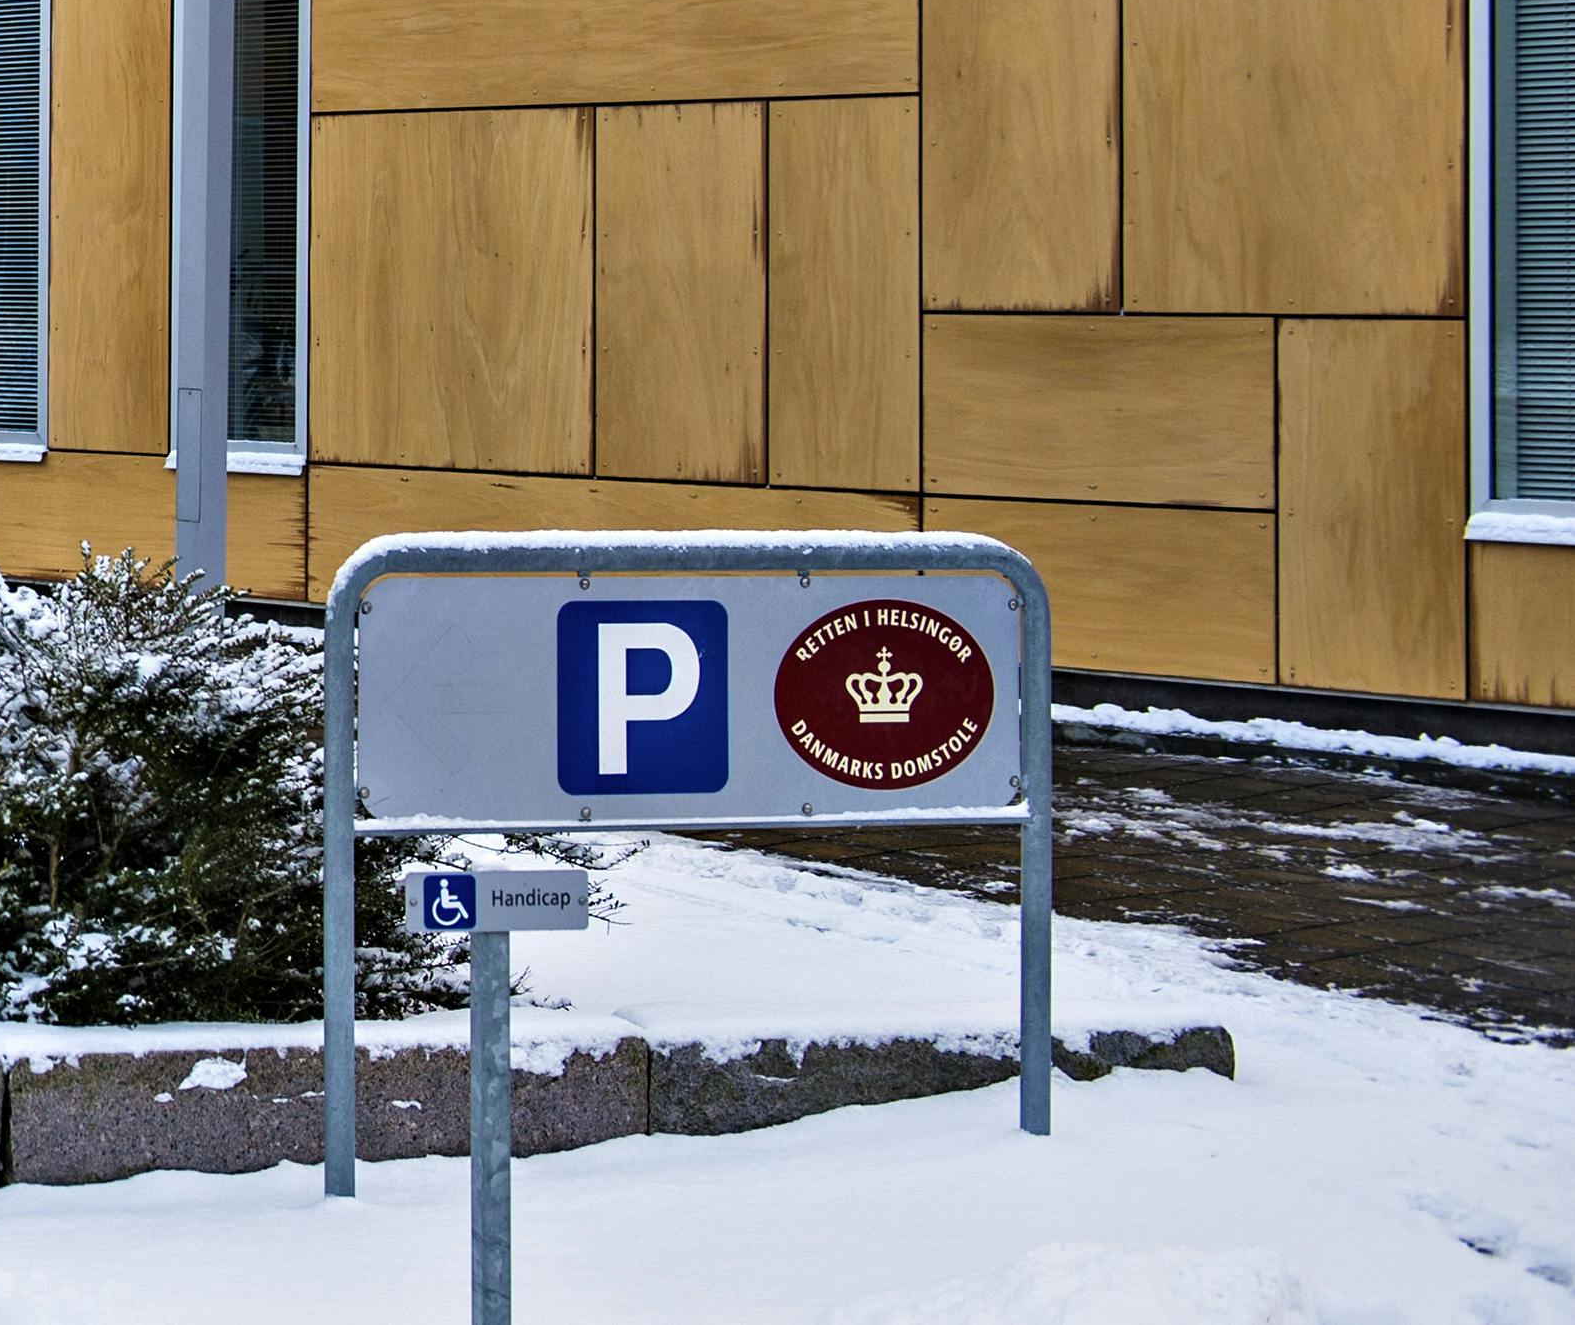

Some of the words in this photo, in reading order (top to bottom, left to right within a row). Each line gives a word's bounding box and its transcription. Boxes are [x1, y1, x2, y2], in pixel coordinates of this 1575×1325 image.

[795, 613, 859, 662] RETTEN
[863, 610, 870, 627] I
[877, 608, 972, 663] HELSINGØR
[598, 622, 700, 775] P
[791, 719, 884, 780] DANMARKS
[890, 717, 978, 780] DOMSTOLE
[491, 887, 571, 909] Handicap
